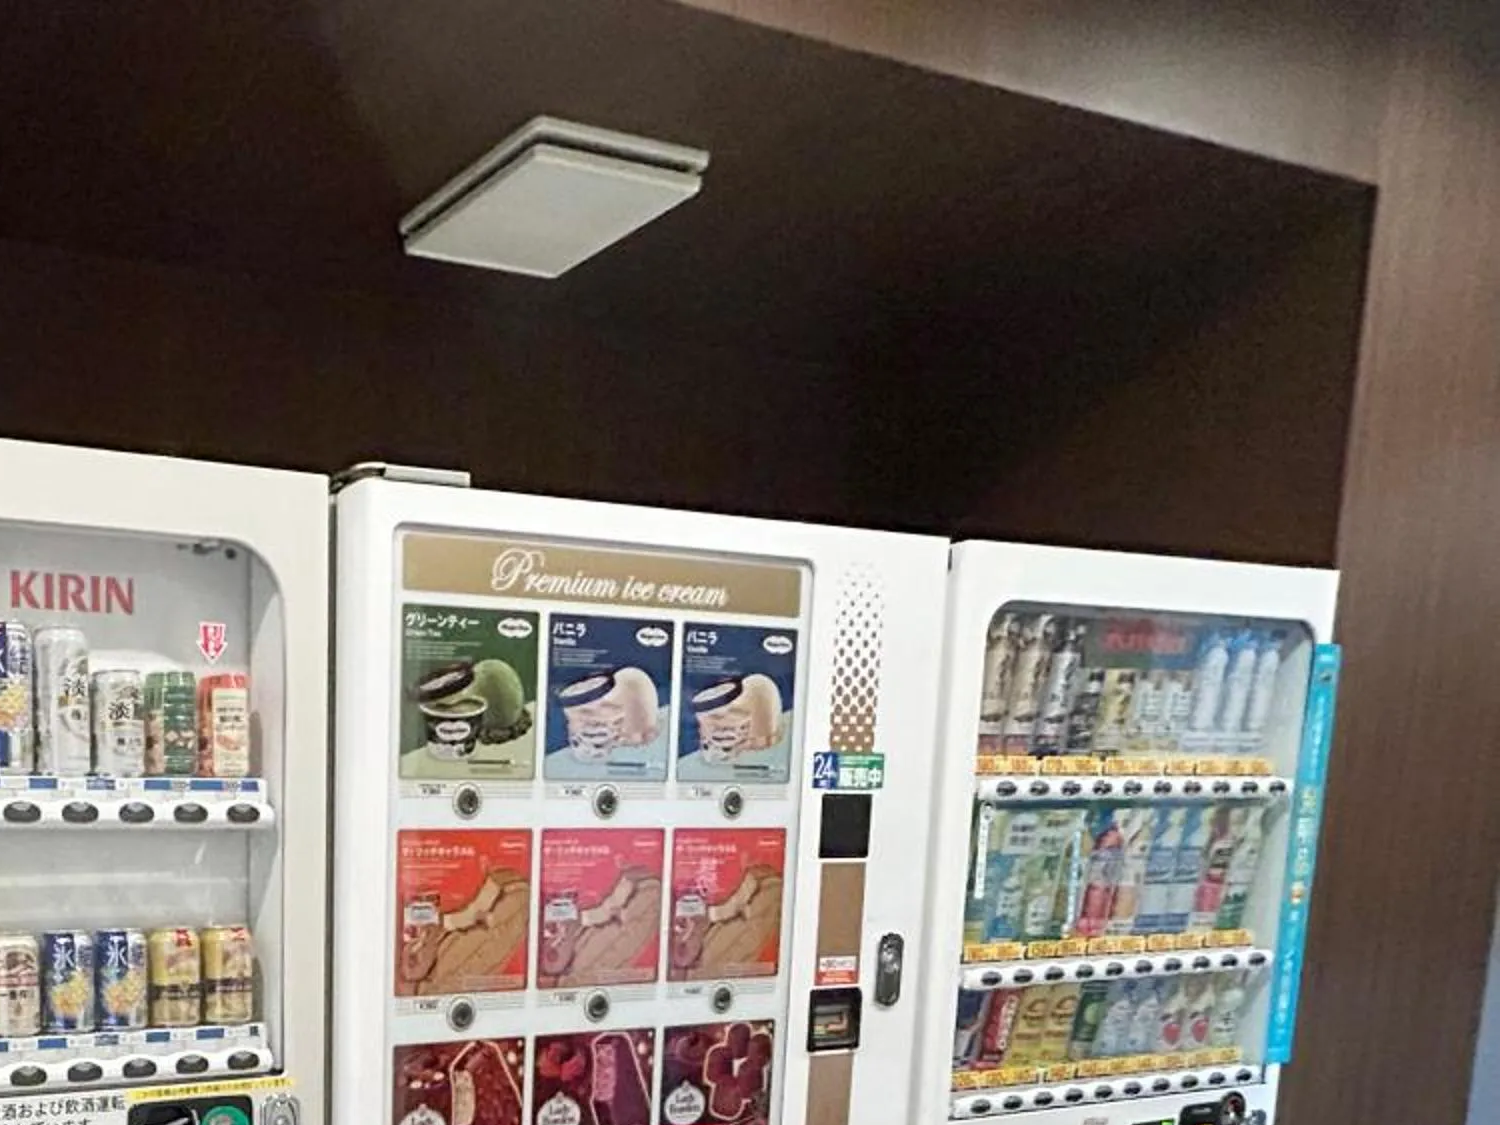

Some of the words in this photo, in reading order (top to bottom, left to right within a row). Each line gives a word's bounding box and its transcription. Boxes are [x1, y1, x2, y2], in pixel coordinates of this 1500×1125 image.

[9, 569, 135, 616] KIRIN
[492, 548, 618, 598] Premium
[657, 583, 730, 607] cream
[552, 621, 587, 637] バニラ
